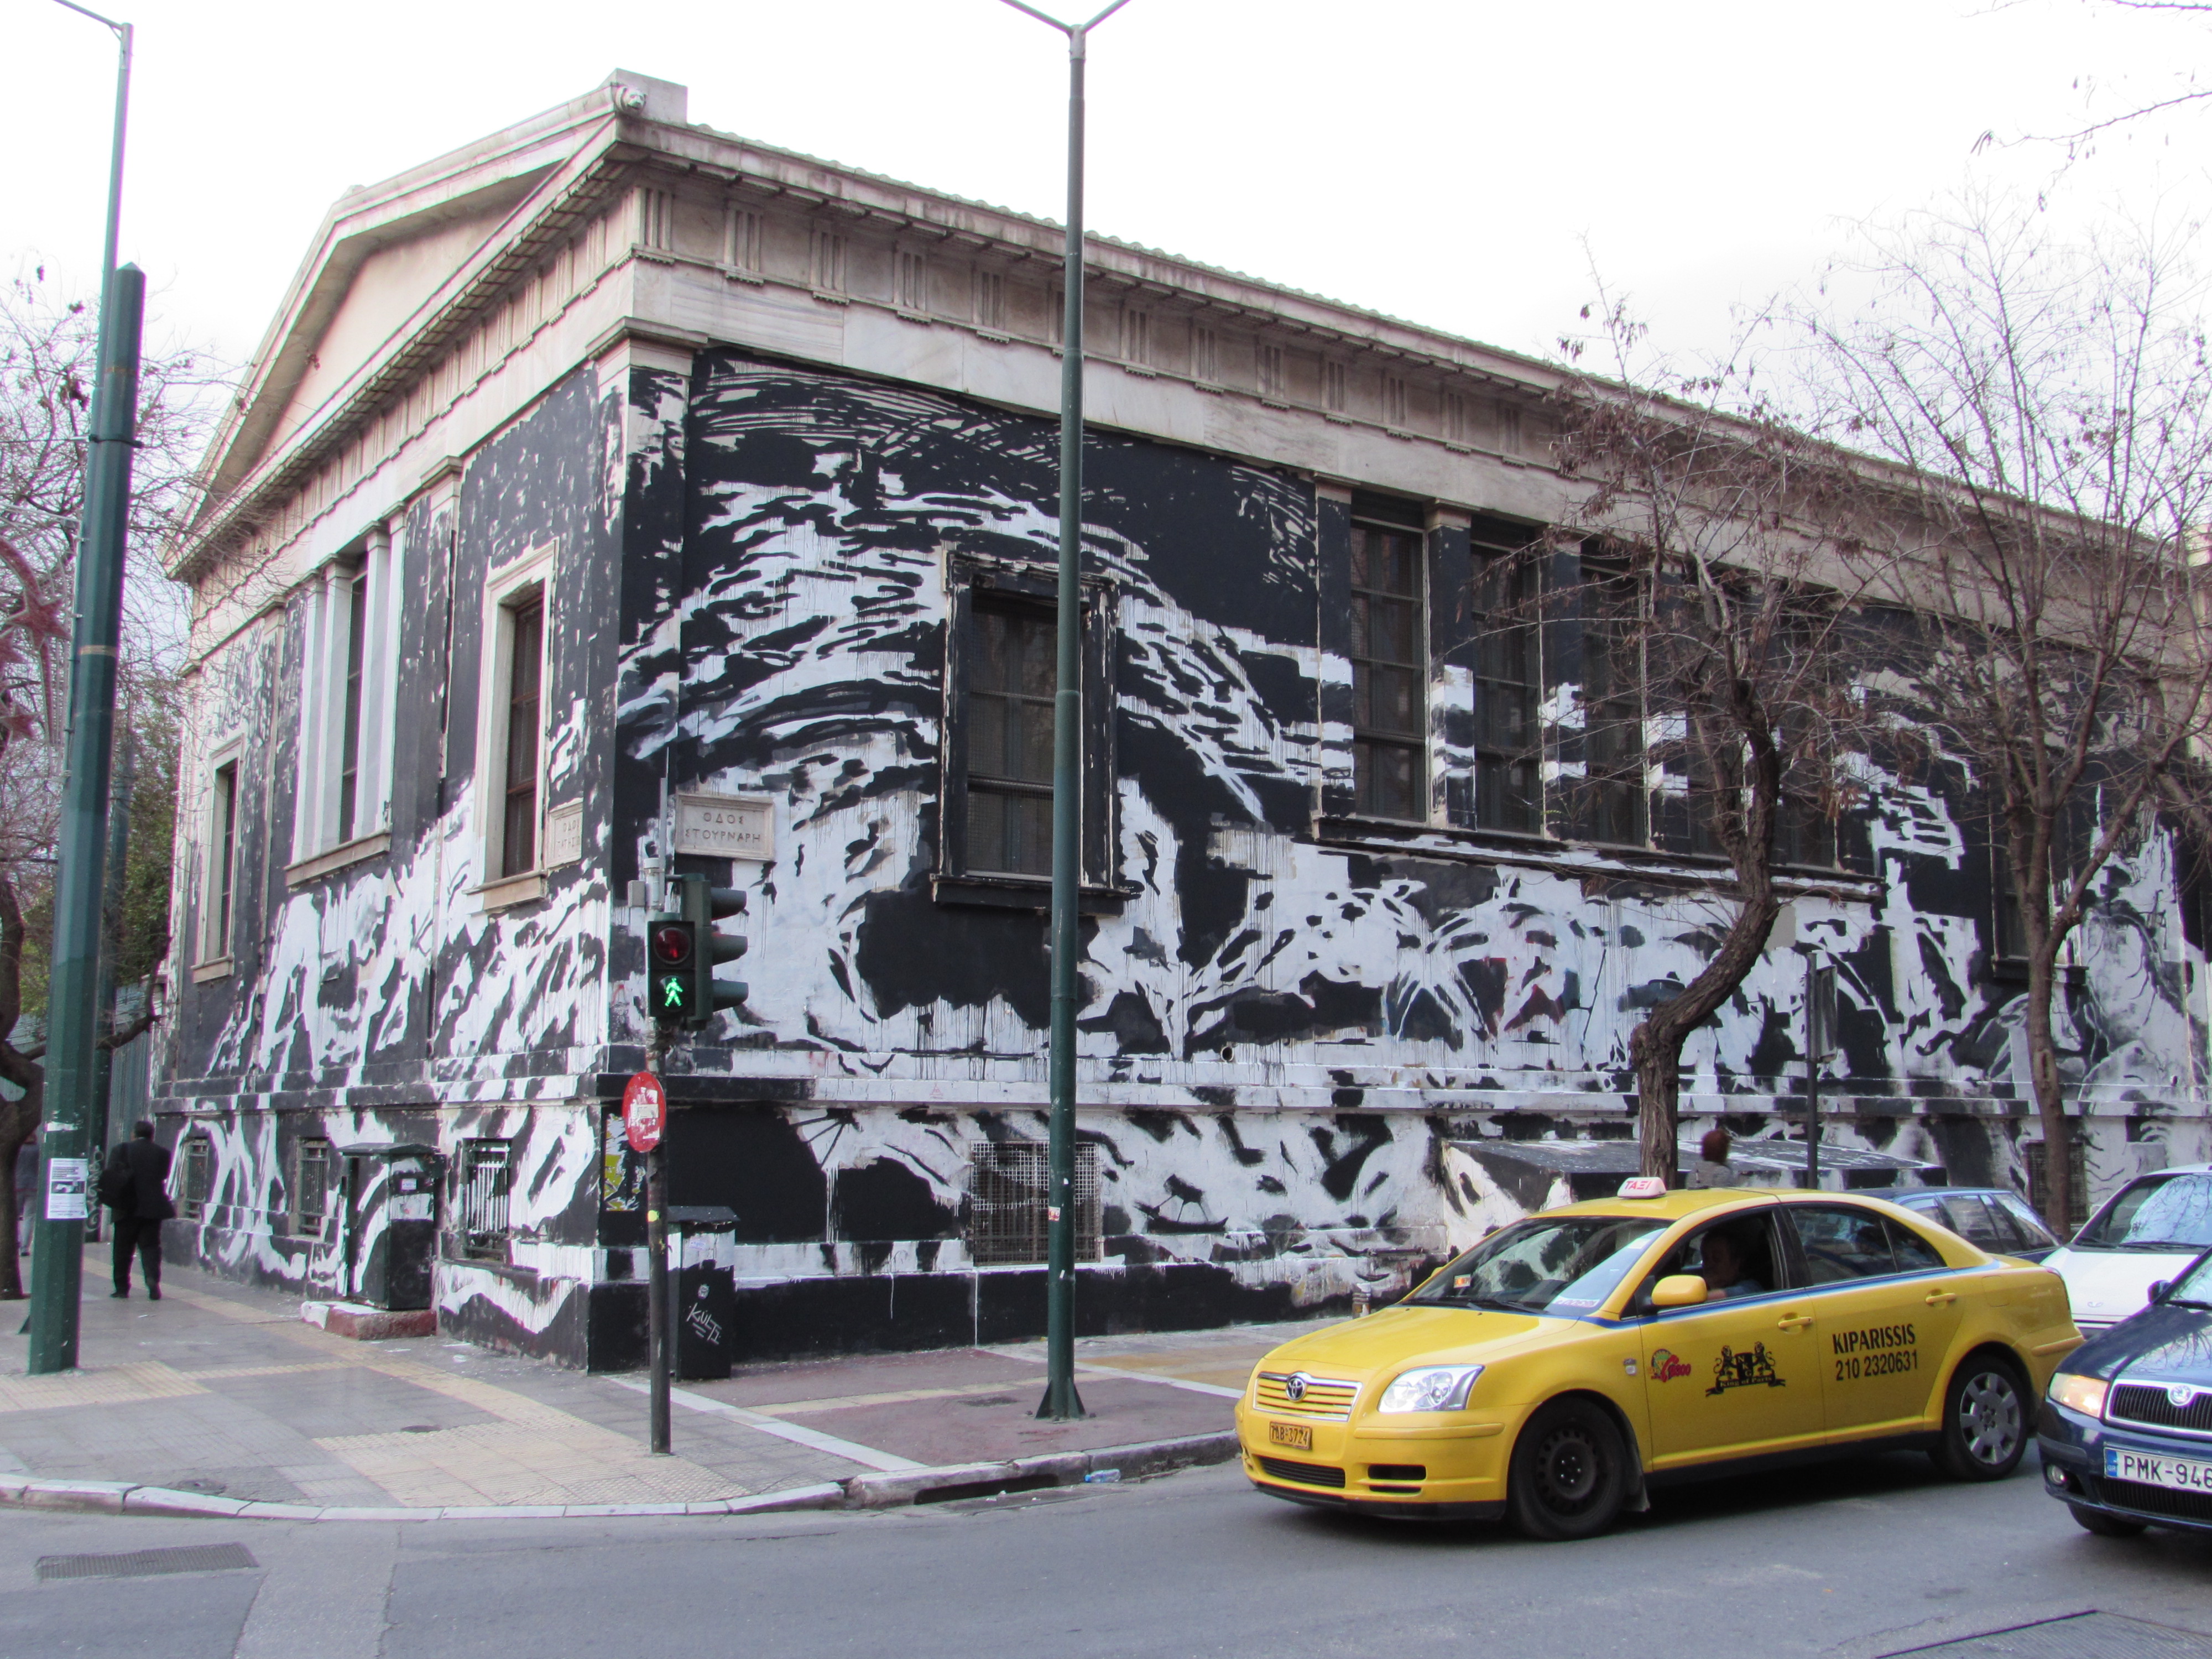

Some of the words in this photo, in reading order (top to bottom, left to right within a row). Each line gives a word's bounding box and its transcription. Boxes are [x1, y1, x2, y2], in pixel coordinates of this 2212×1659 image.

[703, 812, 744, 825] ΟΔΟΣ
[685, 828, 761, 843] ΣΤΟΥΡΝΑΡΗ
[1832, 1323, 1916, 1354] KIPARISSIS
[1835, 1358, 1860, 1381] 210
[1864, 1349, 1917, 1376] 2320631
